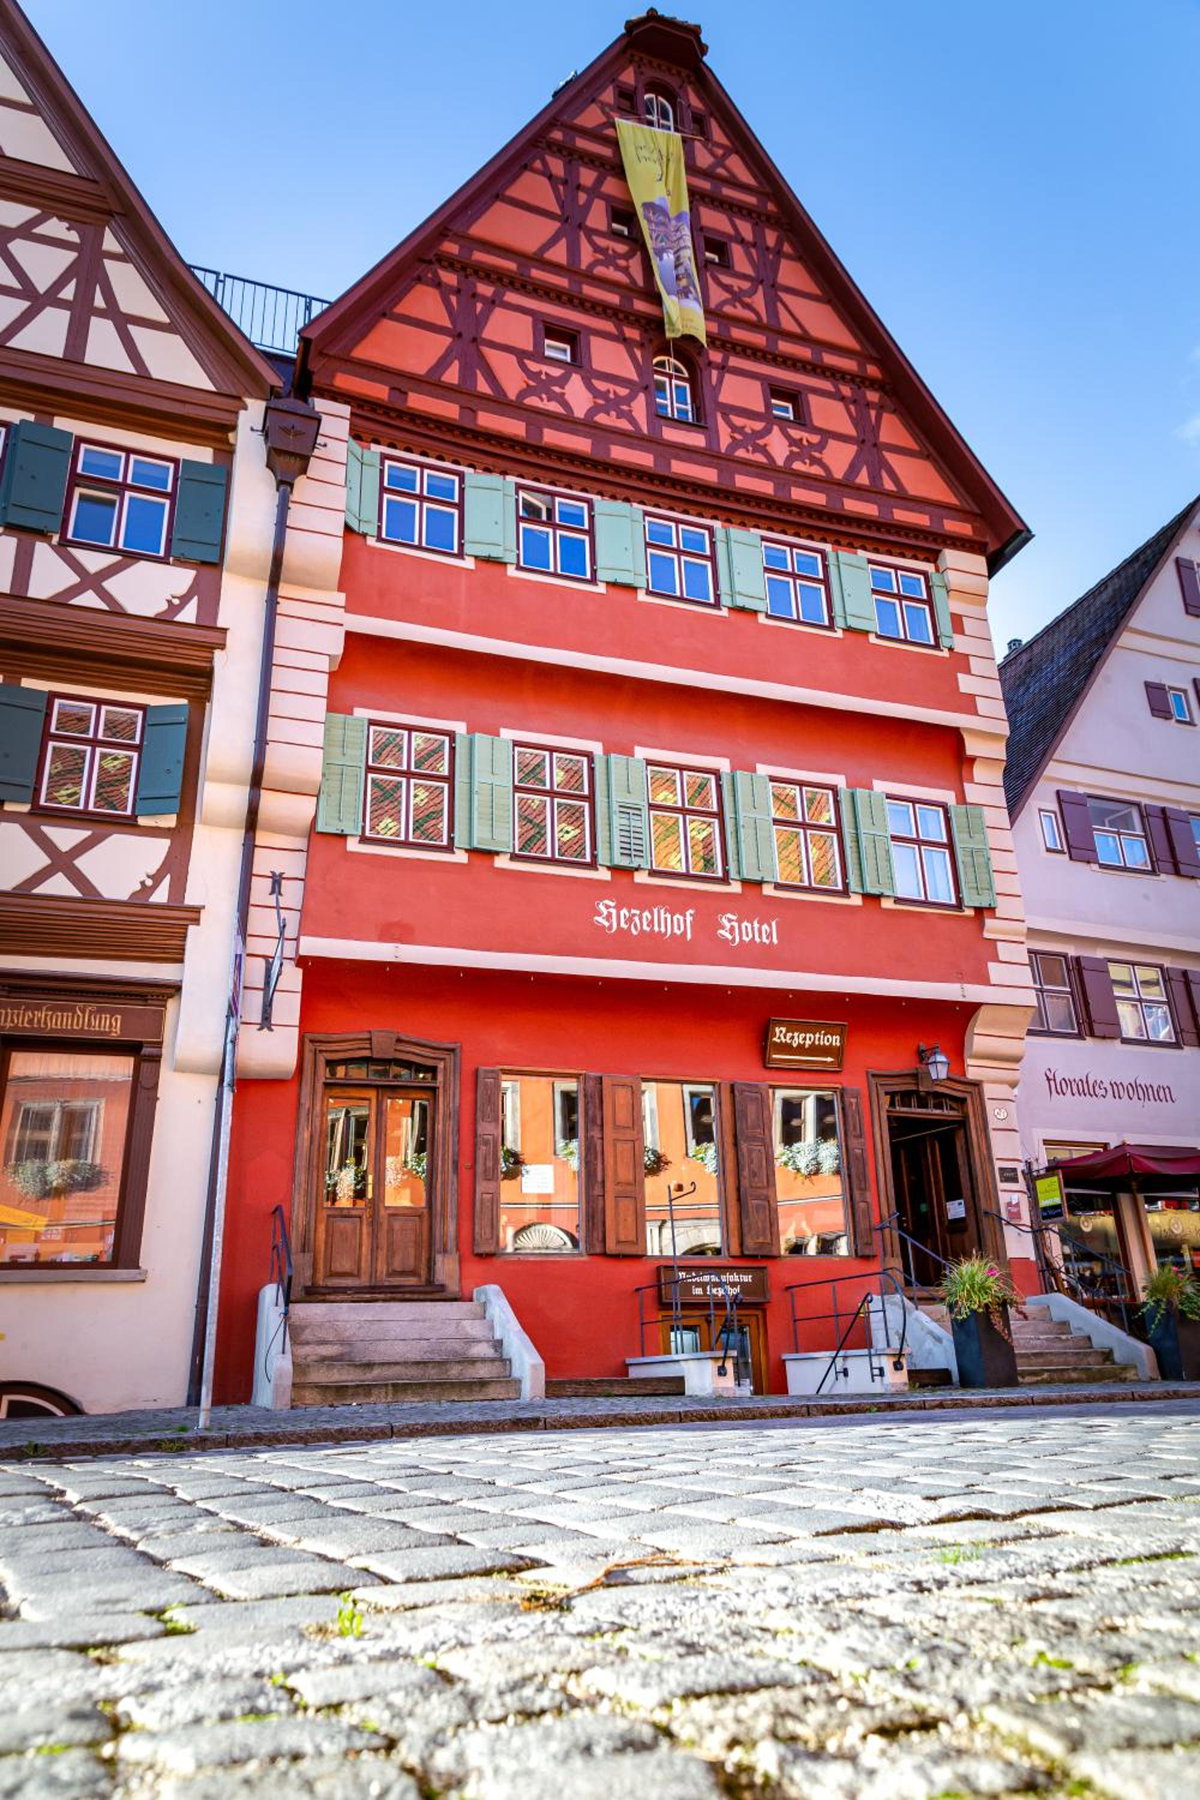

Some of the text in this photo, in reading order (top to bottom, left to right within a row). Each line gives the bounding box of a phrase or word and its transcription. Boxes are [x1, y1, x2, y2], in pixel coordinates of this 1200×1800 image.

[593, 898, 780, 947] Hezelhof Hotel
[772, 1026, 841, 1049] Rezeption
[1109, 1075, 1176, 1108] wohnen
[692, 1285, 704, 1296] im
